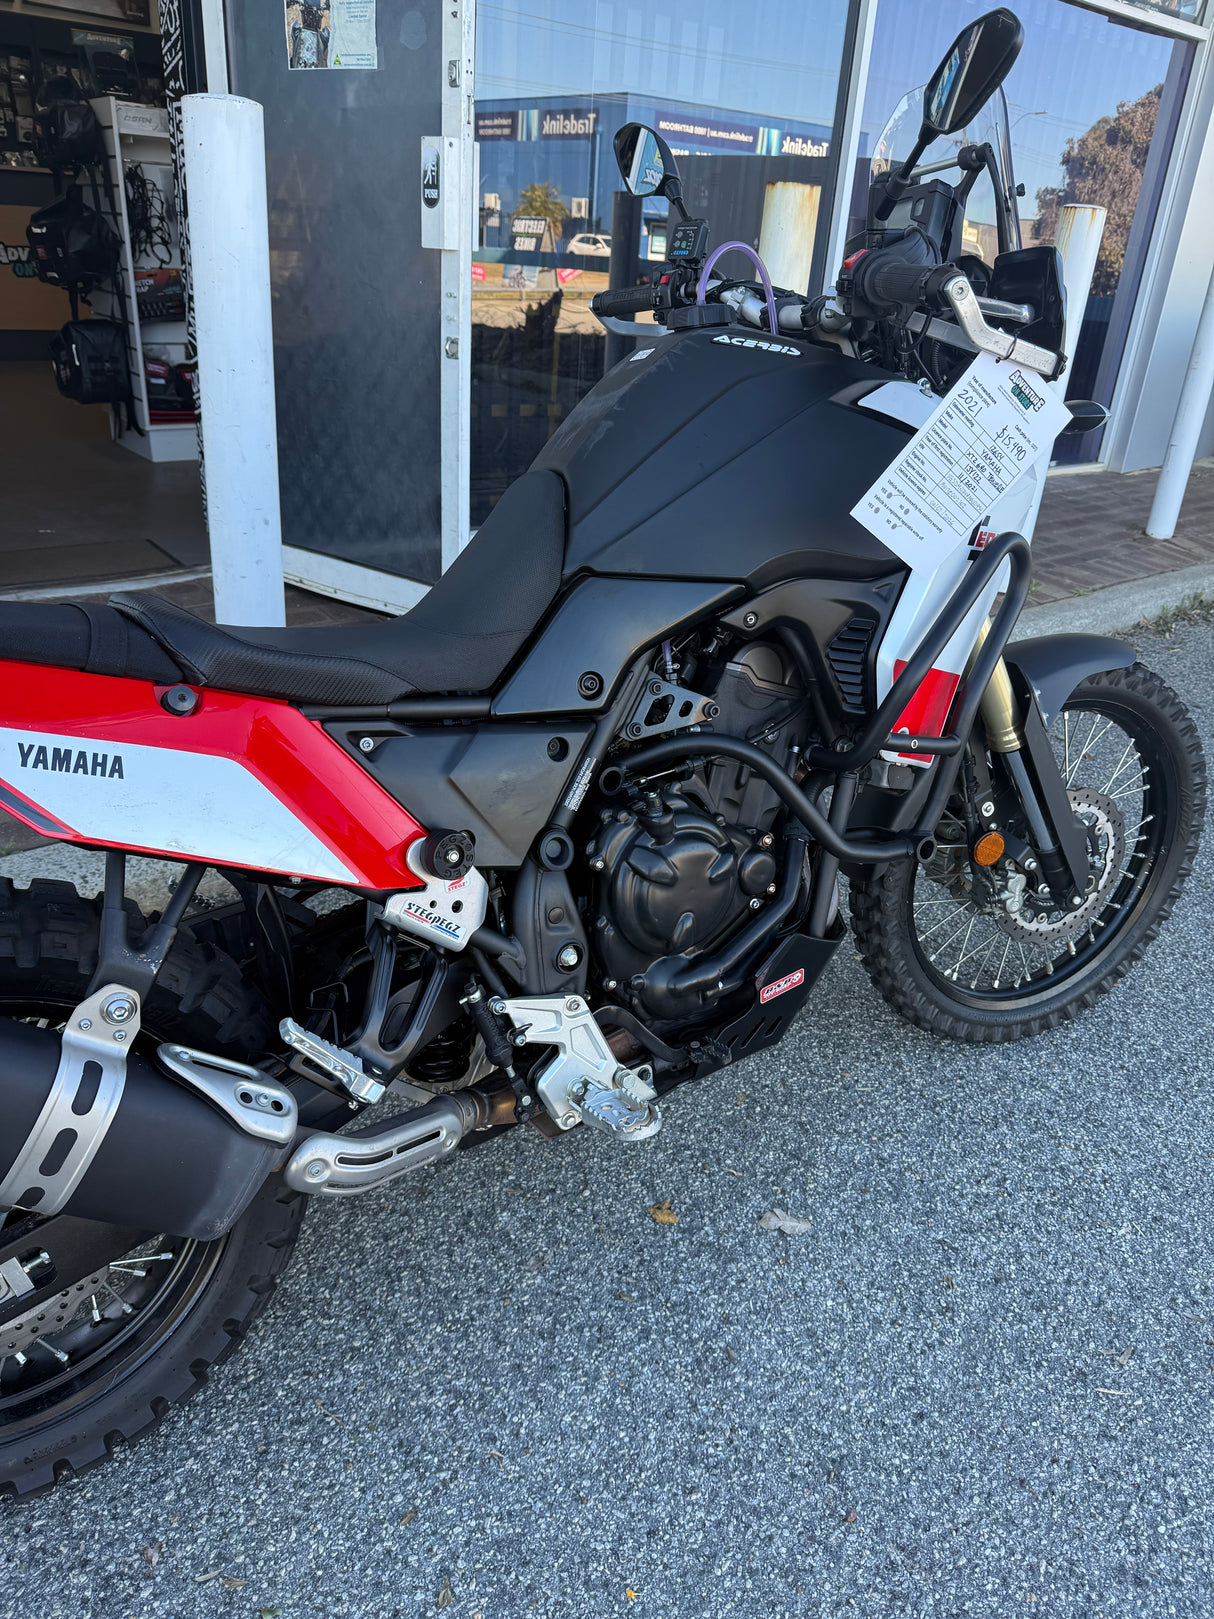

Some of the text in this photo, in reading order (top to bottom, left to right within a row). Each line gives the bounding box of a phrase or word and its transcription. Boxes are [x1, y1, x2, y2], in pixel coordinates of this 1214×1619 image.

[424, 188, 438, 198] PUSH
[0, 241, 30, 264] ADV
[980, 386, 996, 404] manufacture
[1009, 370, 1045, 411] ADVENTURE
[1011, 384, 1021, 396] ON
[1017, 391, 1032, 409] STORE
[945, 410, 953, 419] Make
[952, 401, 974, 427] Odometer reading
[957, 389, 982, 417] 2021
[931, 427, 942, 438] Licence
[938, 418, 948, 428] Model
[904, 458, 915, 471] Register
[911, 450, 920, 461] Engine
[939, 450, 953, 465] registration
[981, 449, 1001, 475] YAMAHA
[898, 466, 925, 495] Vehicle licence expires
[958, 472, 977, 492] 11/2021
[874, 494, 884, 504] Vehicle
[888, 508, 902, 520] registered
[900, 519, 913, 531] repairable
[887, 479, 897, 489] Vehicle
[904, 496, 915, 506] covered
[921, 512, 932, 524] statutory
[931, 522, 942, 533] warranty
[18, 742, 124, 779] YAMAHA
[406, 902, 461, 934] STEGPEGZ
